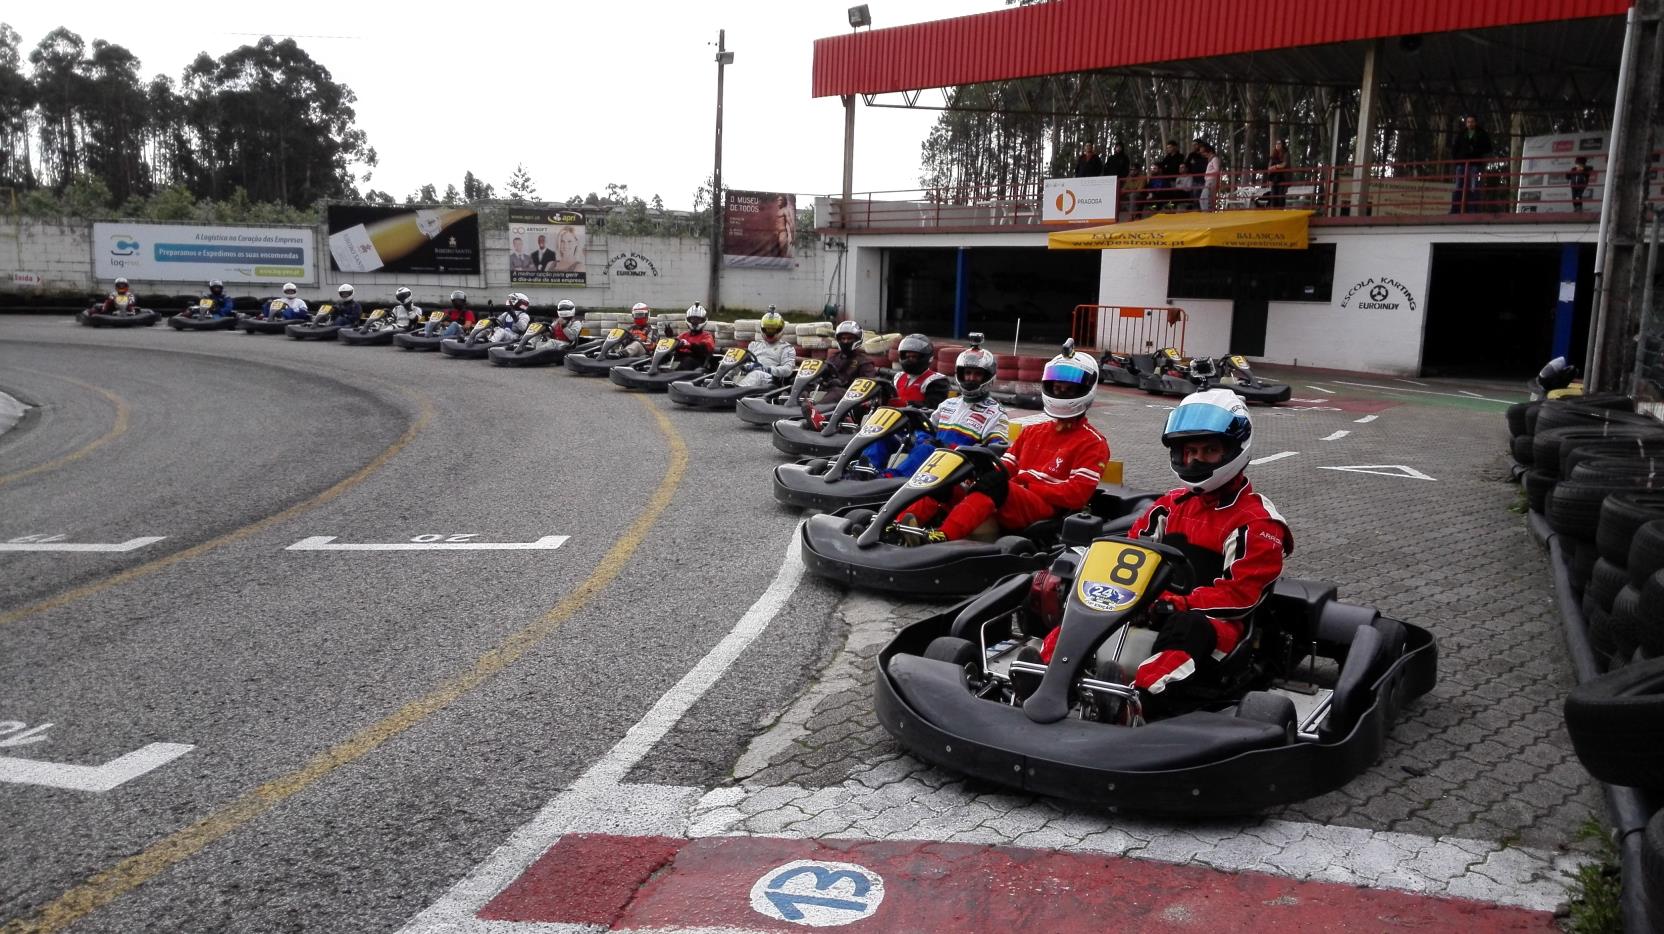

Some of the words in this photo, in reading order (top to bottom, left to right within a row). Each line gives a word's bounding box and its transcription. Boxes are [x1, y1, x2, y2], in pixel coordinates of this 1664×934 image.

[740, 205, 759, 213] TODOS
[159, 248, 197, 258] Preparamos
[1341, 278, 1375, 308] ESCOLA
[1381, 277, 1417, 311] KARTING
[1358, 302, 1400, 310] EUROINDY
[801, 360, 820, 371] 22
[850, 380, 873, 393] 29
[874, 409, 896, 426] 11
[924, 452, 948, 473] 4
[1109, 548, 1147, 586] 8
[1091, 585, 1114, 598] 24
[764, 865, 872, 921] 13
